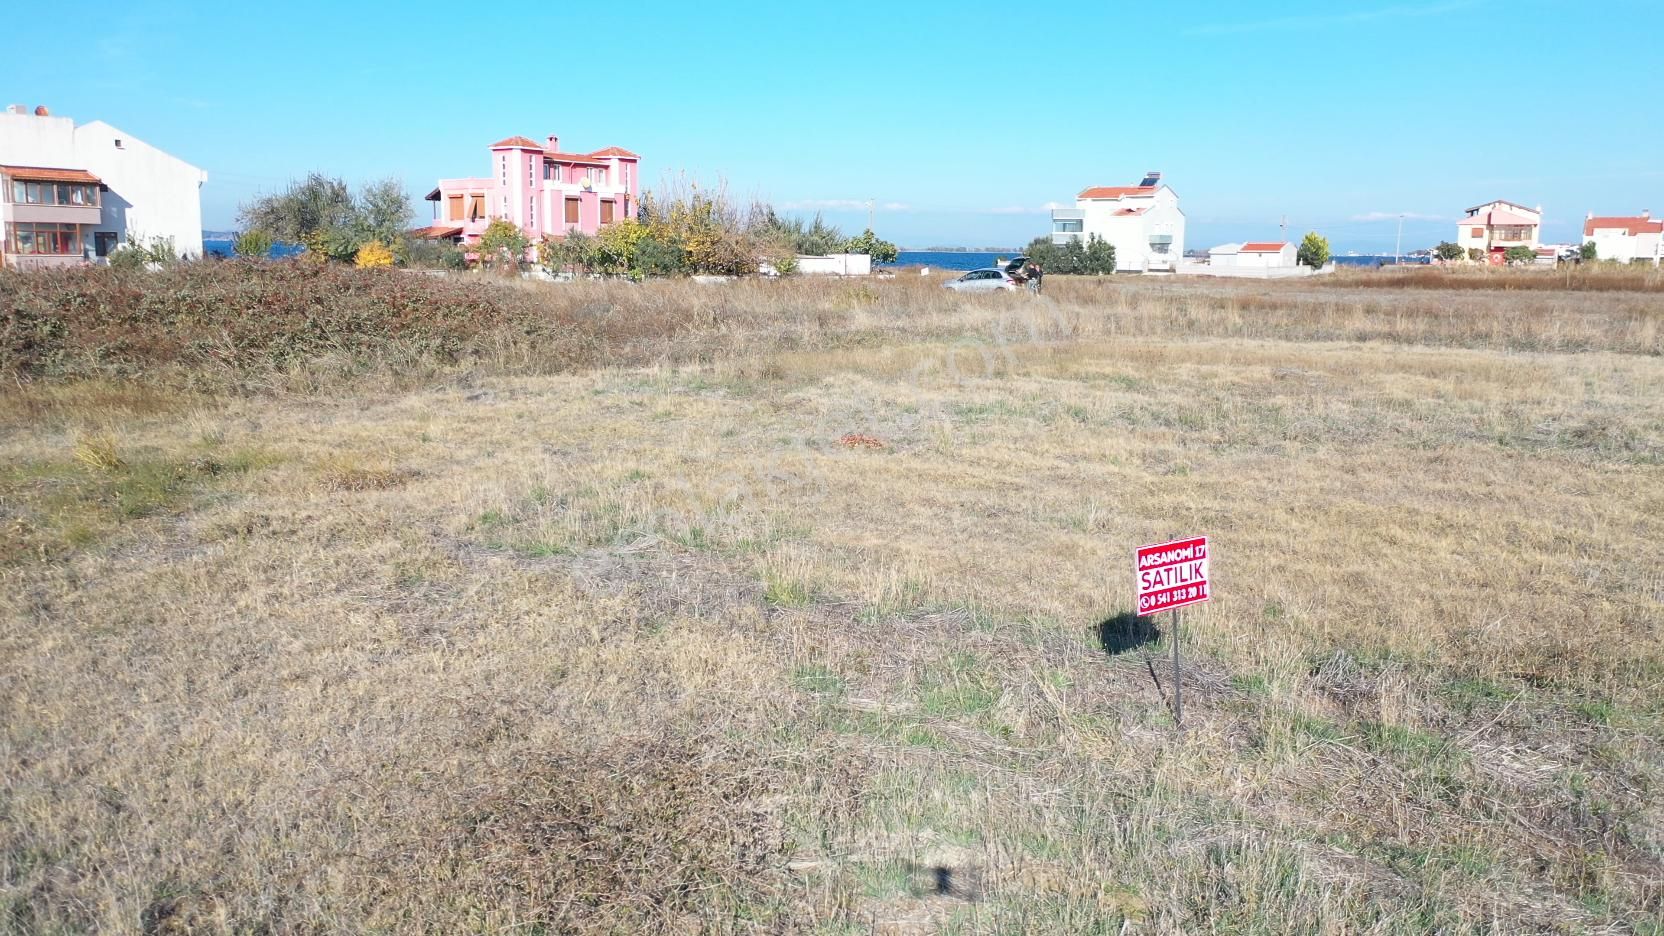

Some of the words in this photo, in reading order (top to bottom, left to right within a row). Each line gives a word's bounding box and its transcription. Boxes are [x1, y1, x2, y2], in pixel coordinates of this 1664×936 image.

[1195, 545, 1205, 557] 17
[1141, 561, 1204, 590] SATILIK
[1150, 595, 1156, 606] 0
[1157, 591, 1170, 605] 541
[1172, 588, 1186, 602] 313
[1188, 586, 1197, 598] 20
[1199, 584, 1207, 596] 11
